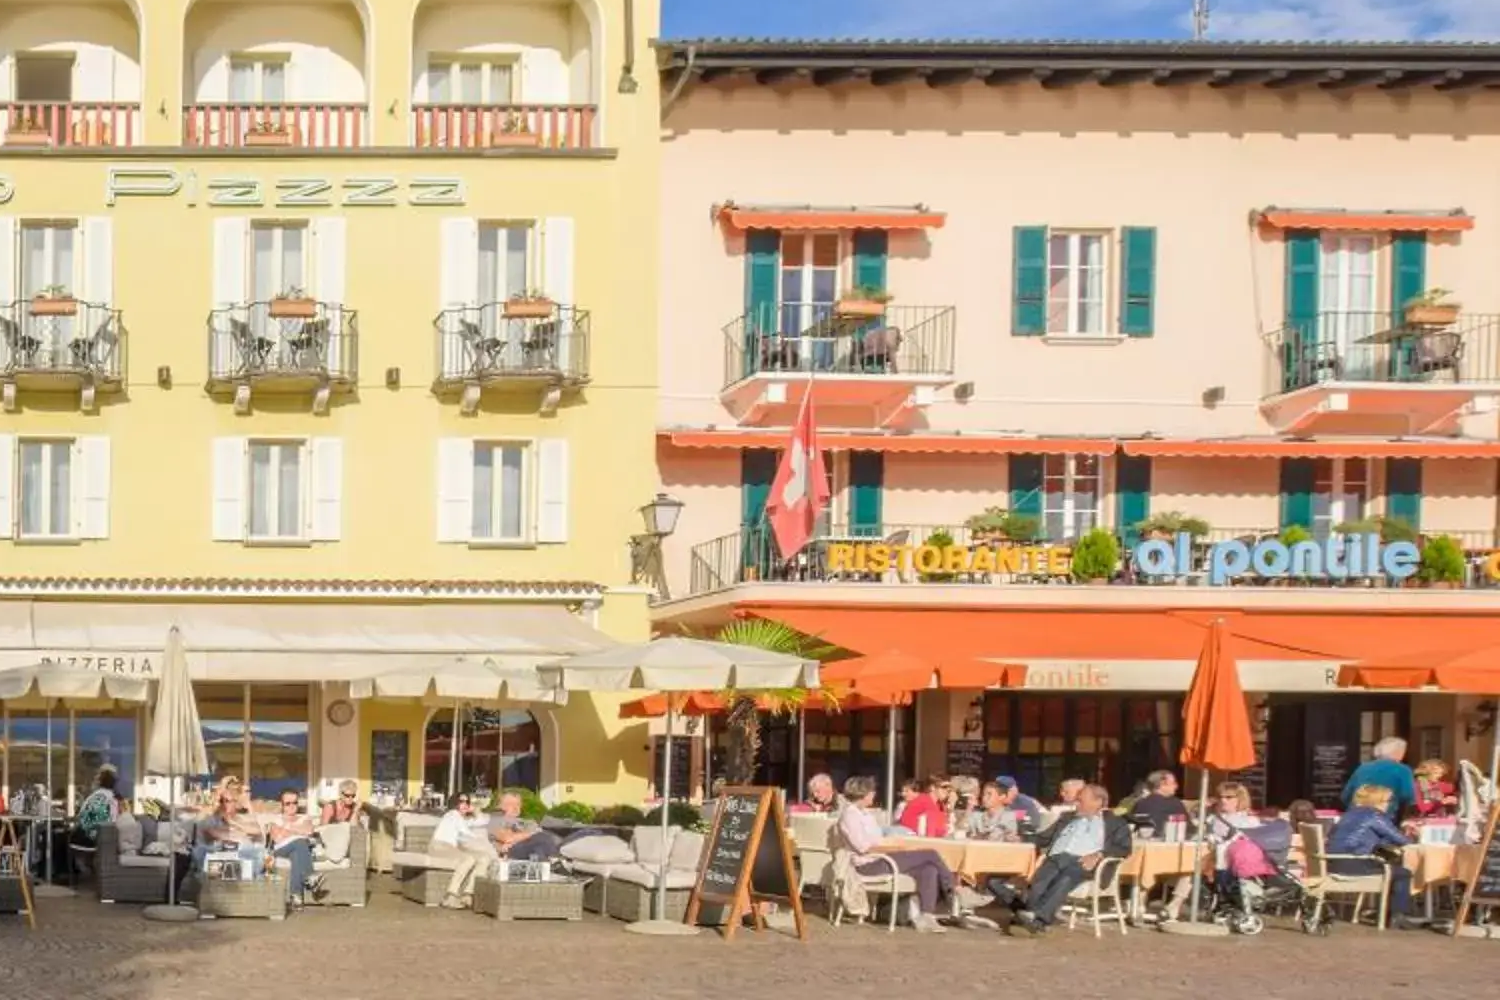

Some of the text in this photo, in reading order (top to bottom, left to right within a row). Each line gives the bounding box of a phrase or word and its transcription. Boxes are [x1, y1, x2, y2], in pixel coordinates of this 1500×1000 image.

[105, 168, 466, 208] Piazza
[827, 543, 1073, 575] RISTORANTE
[1136, 532, 1422, 585] al pontile
